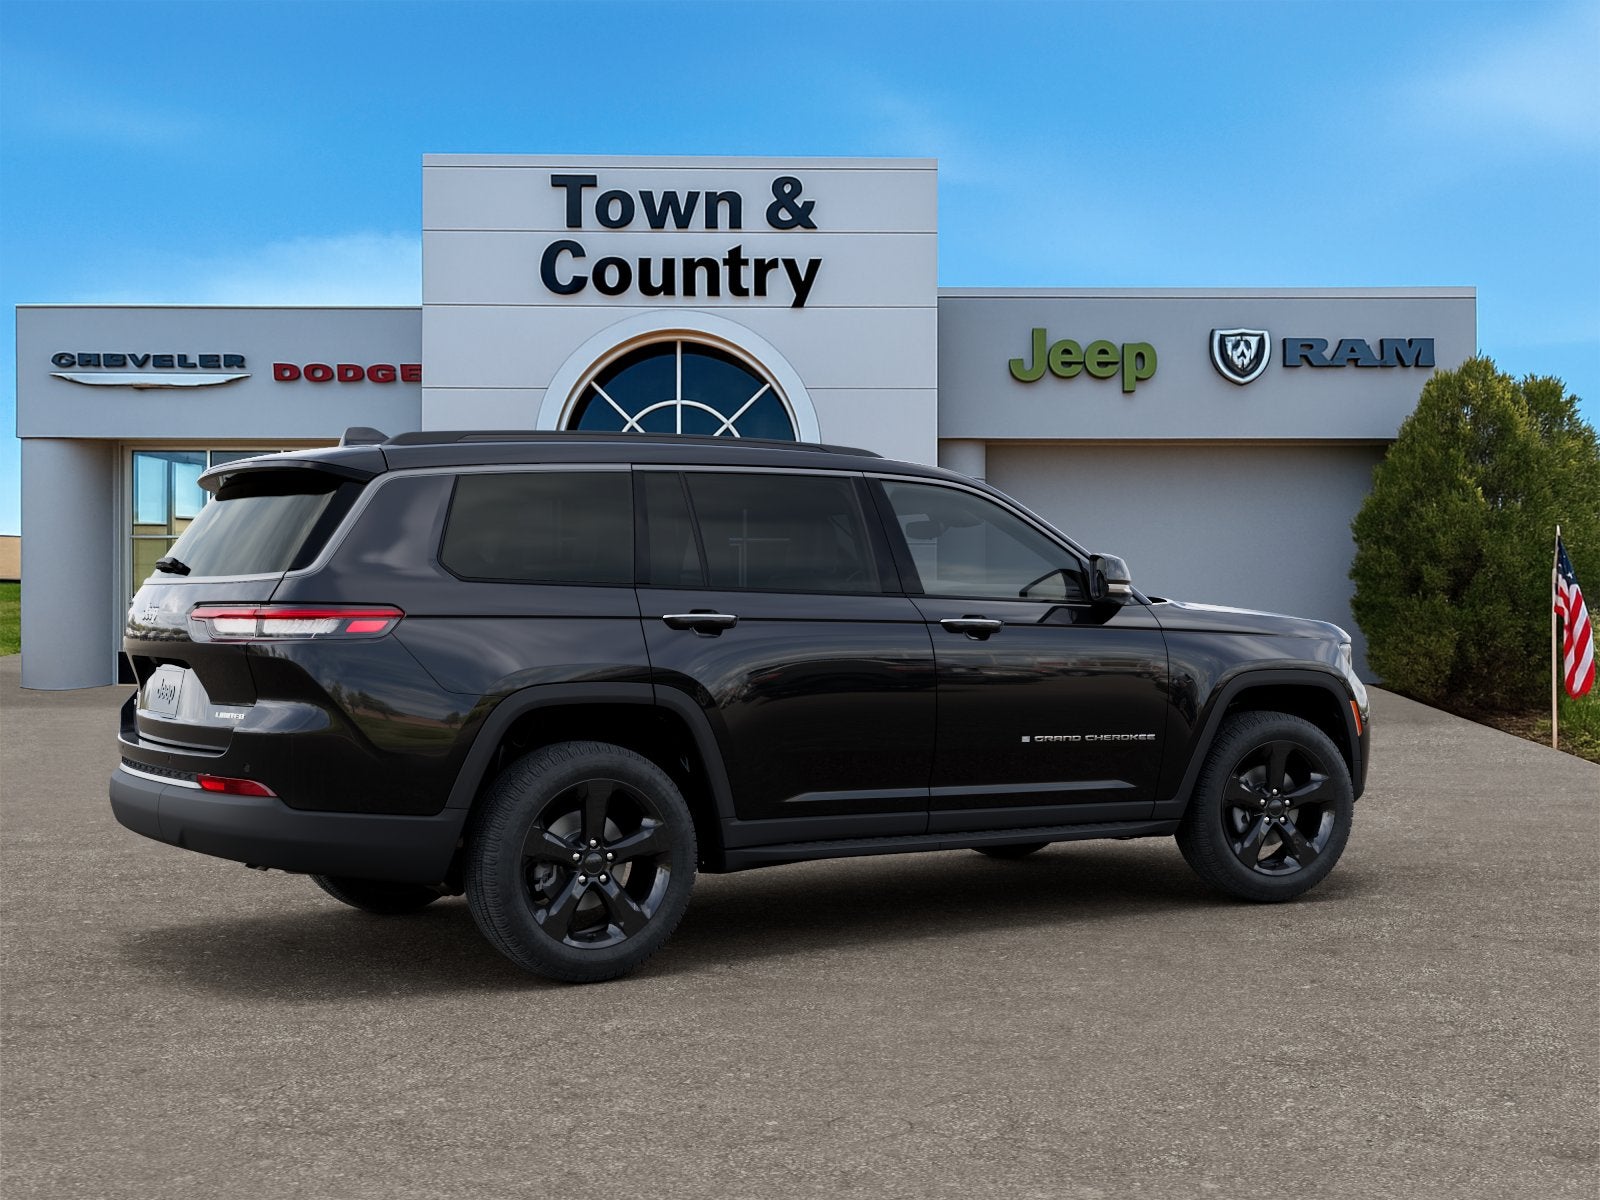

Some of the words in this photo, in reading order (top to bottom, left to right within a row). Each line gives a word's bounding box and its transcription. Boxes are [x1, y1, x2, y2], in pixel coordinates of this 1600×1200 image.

[550, 174, 742, 229] Town
[765, 176, 818, 230] &
[540, 239, 822, 308] Country
[272, 362, 422, 384] DODGE
[1009, 328, 1157, 393] Jeep
[1282, 337, 1435, 368] RAM
[1084, 733, 1156, 741] CHEROKEE
